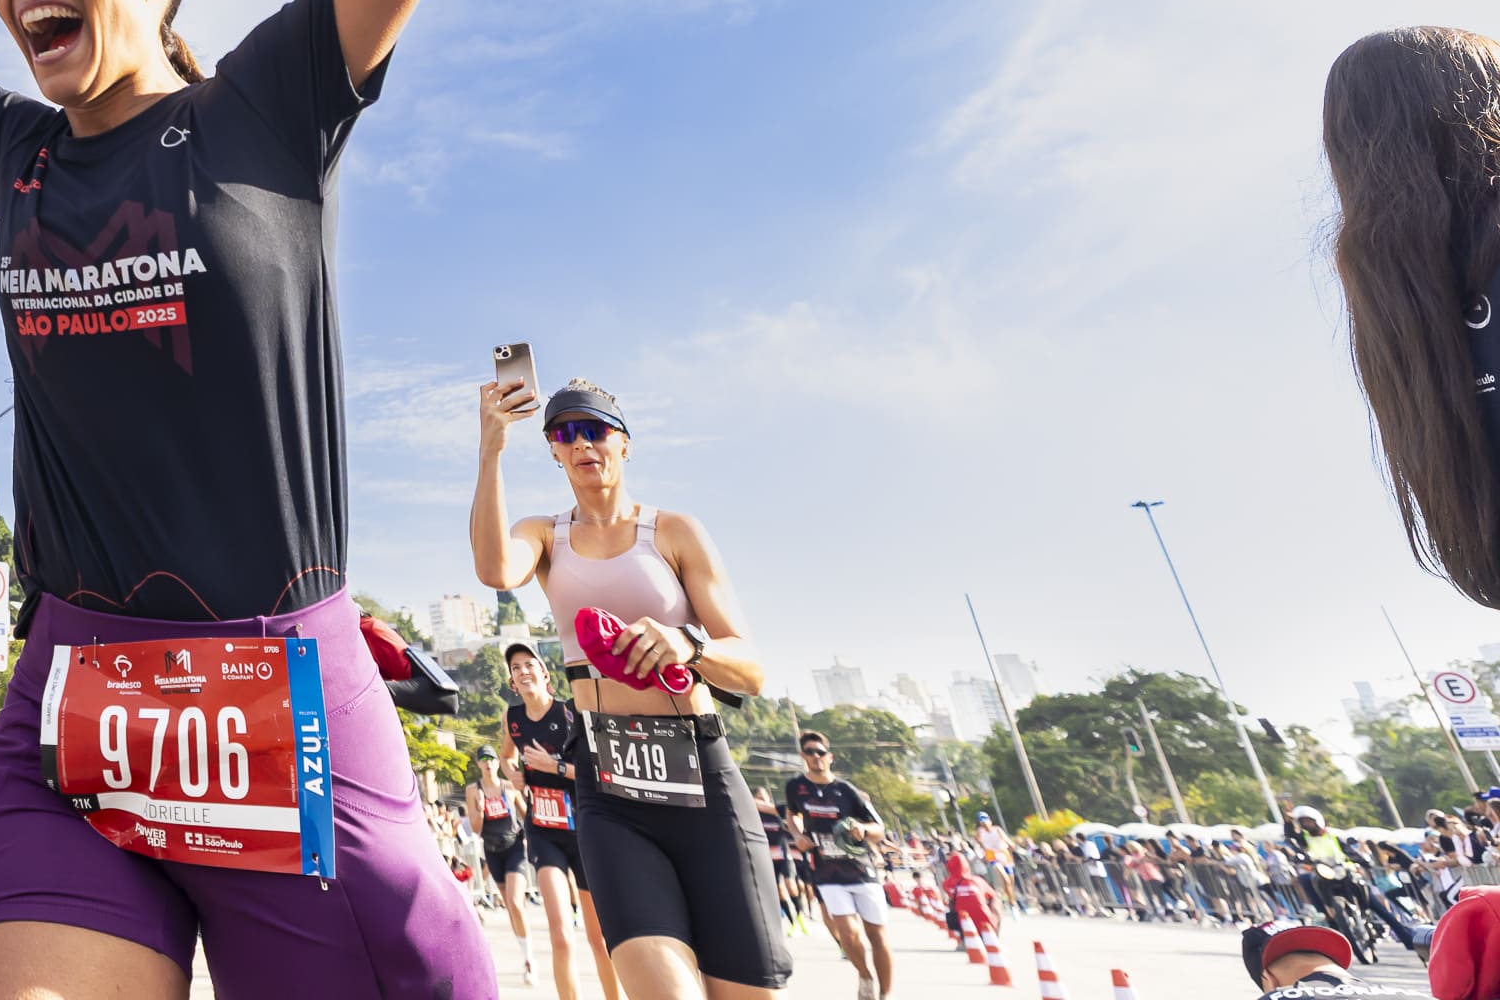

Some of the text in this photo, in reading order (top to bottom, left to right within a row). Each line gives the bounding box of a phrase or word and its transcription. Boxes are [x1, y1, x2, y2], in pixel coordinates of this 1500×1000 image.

[0, 247, 207, 294] MEIA MARATONA
[12, 282, 184, 309] INTERNACIONAL DA CIDADE DE
[16, 307, 177, 336] SÃO PAULO 2025
[221, 663, 254, 675] BAIN
[107, 680, 142, 690] bradesco
[1444, 679, 1466, 697] E
[99, 705, 250, 800] 9706
[301, 717, 325, 797] AZUL
[609, 739, 668, 782] 5419
[72, 798, 92, 809] 21K
